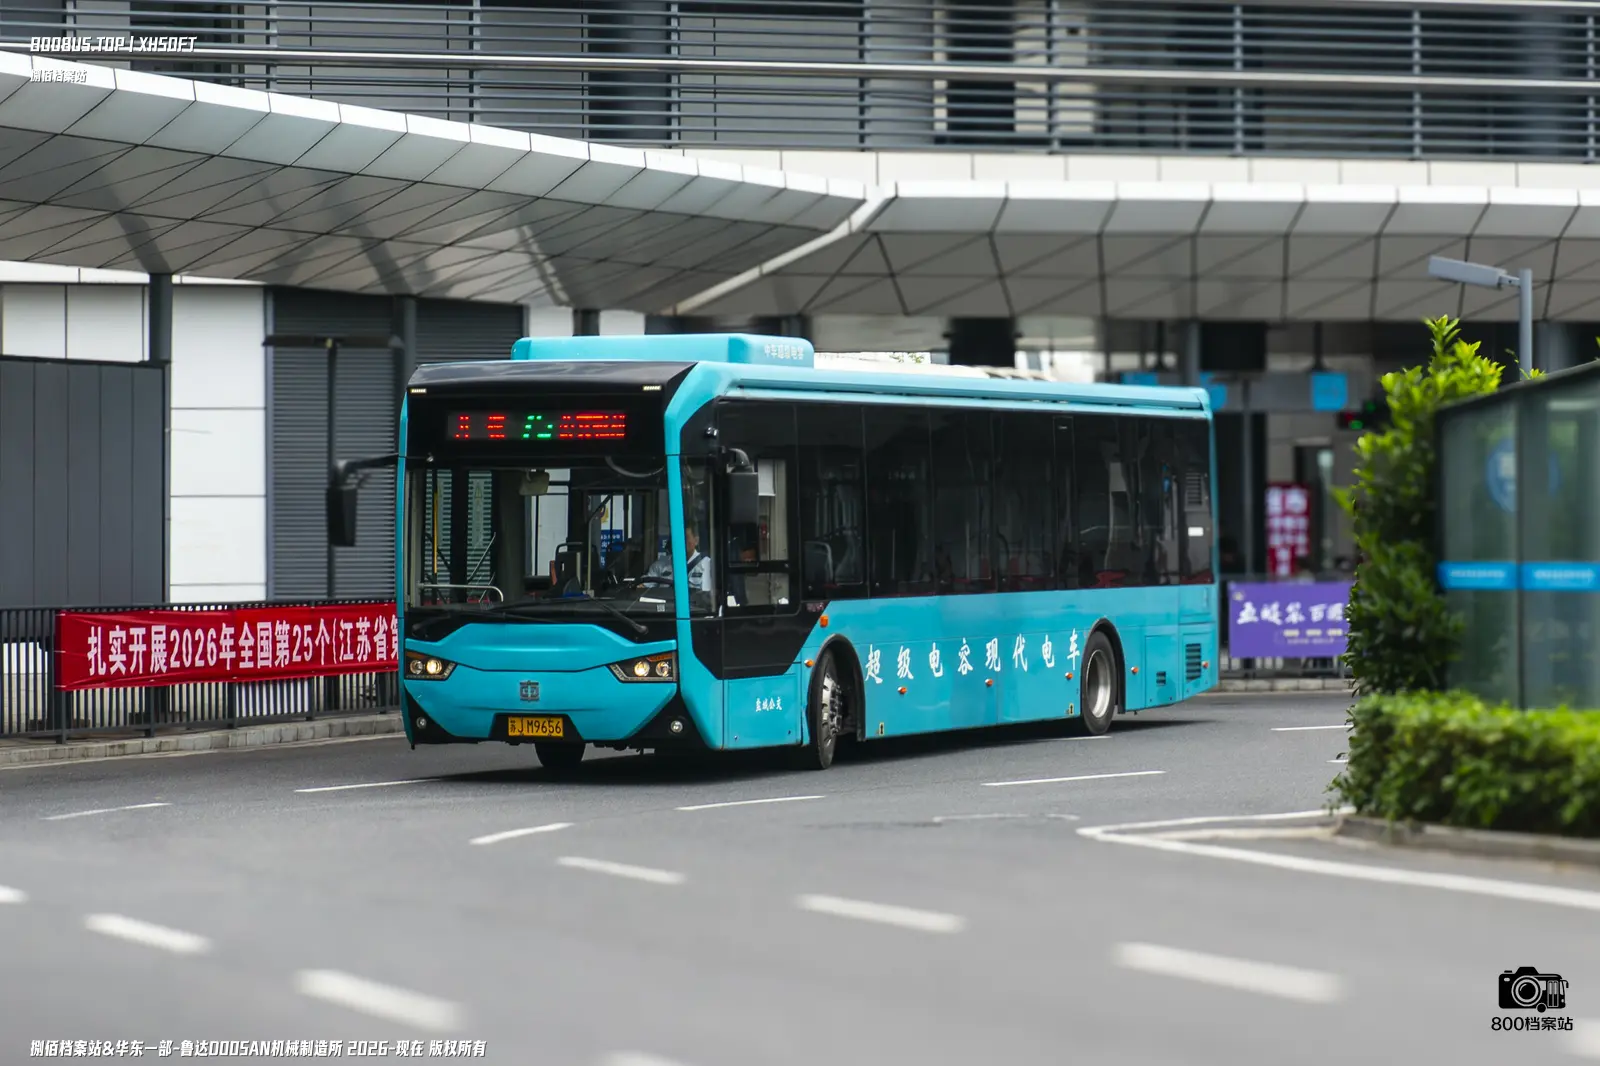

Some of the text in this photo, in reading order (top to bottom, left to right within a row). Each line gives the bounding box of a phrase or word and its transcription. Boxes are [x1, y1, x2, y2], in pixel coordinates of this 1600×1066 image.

[865, 628, 1081, 684] 超级电容现代电车
[755, 696, 783, 712] 盐城公交
